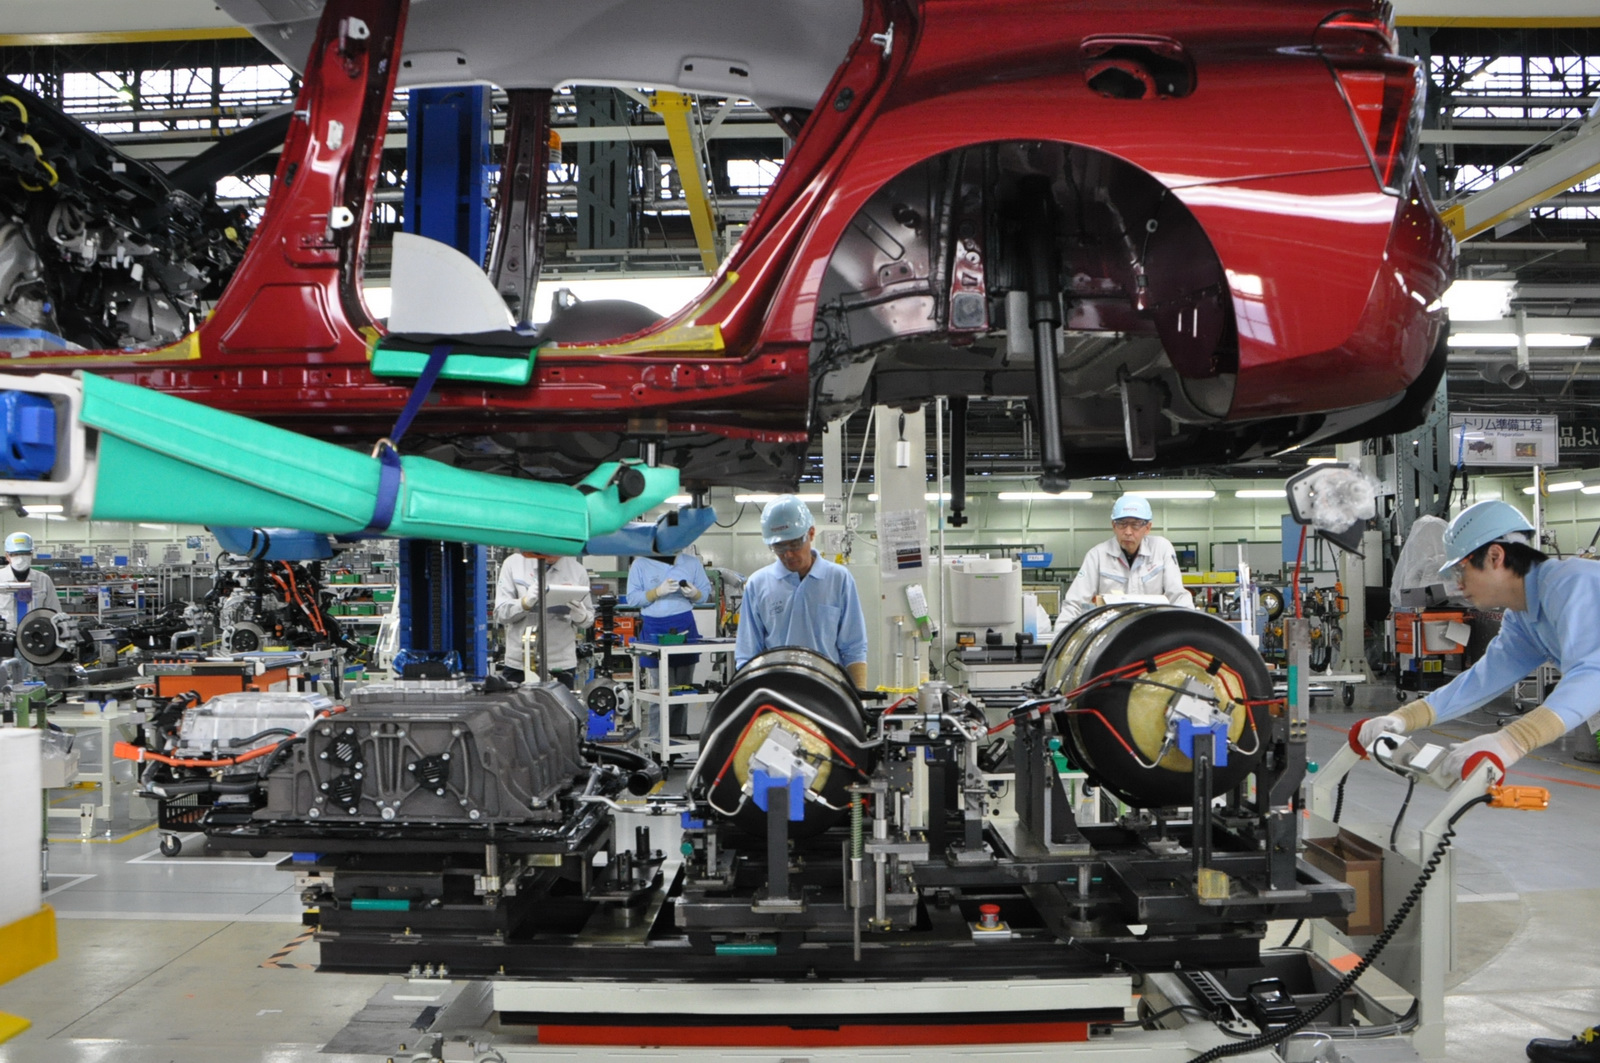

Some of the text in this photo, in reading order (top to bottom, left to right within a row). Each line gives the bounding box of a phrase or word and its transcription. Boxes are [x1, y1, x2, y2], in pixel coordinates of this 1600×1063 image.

[1463, 418, 1543, 432] トリム準備工程
